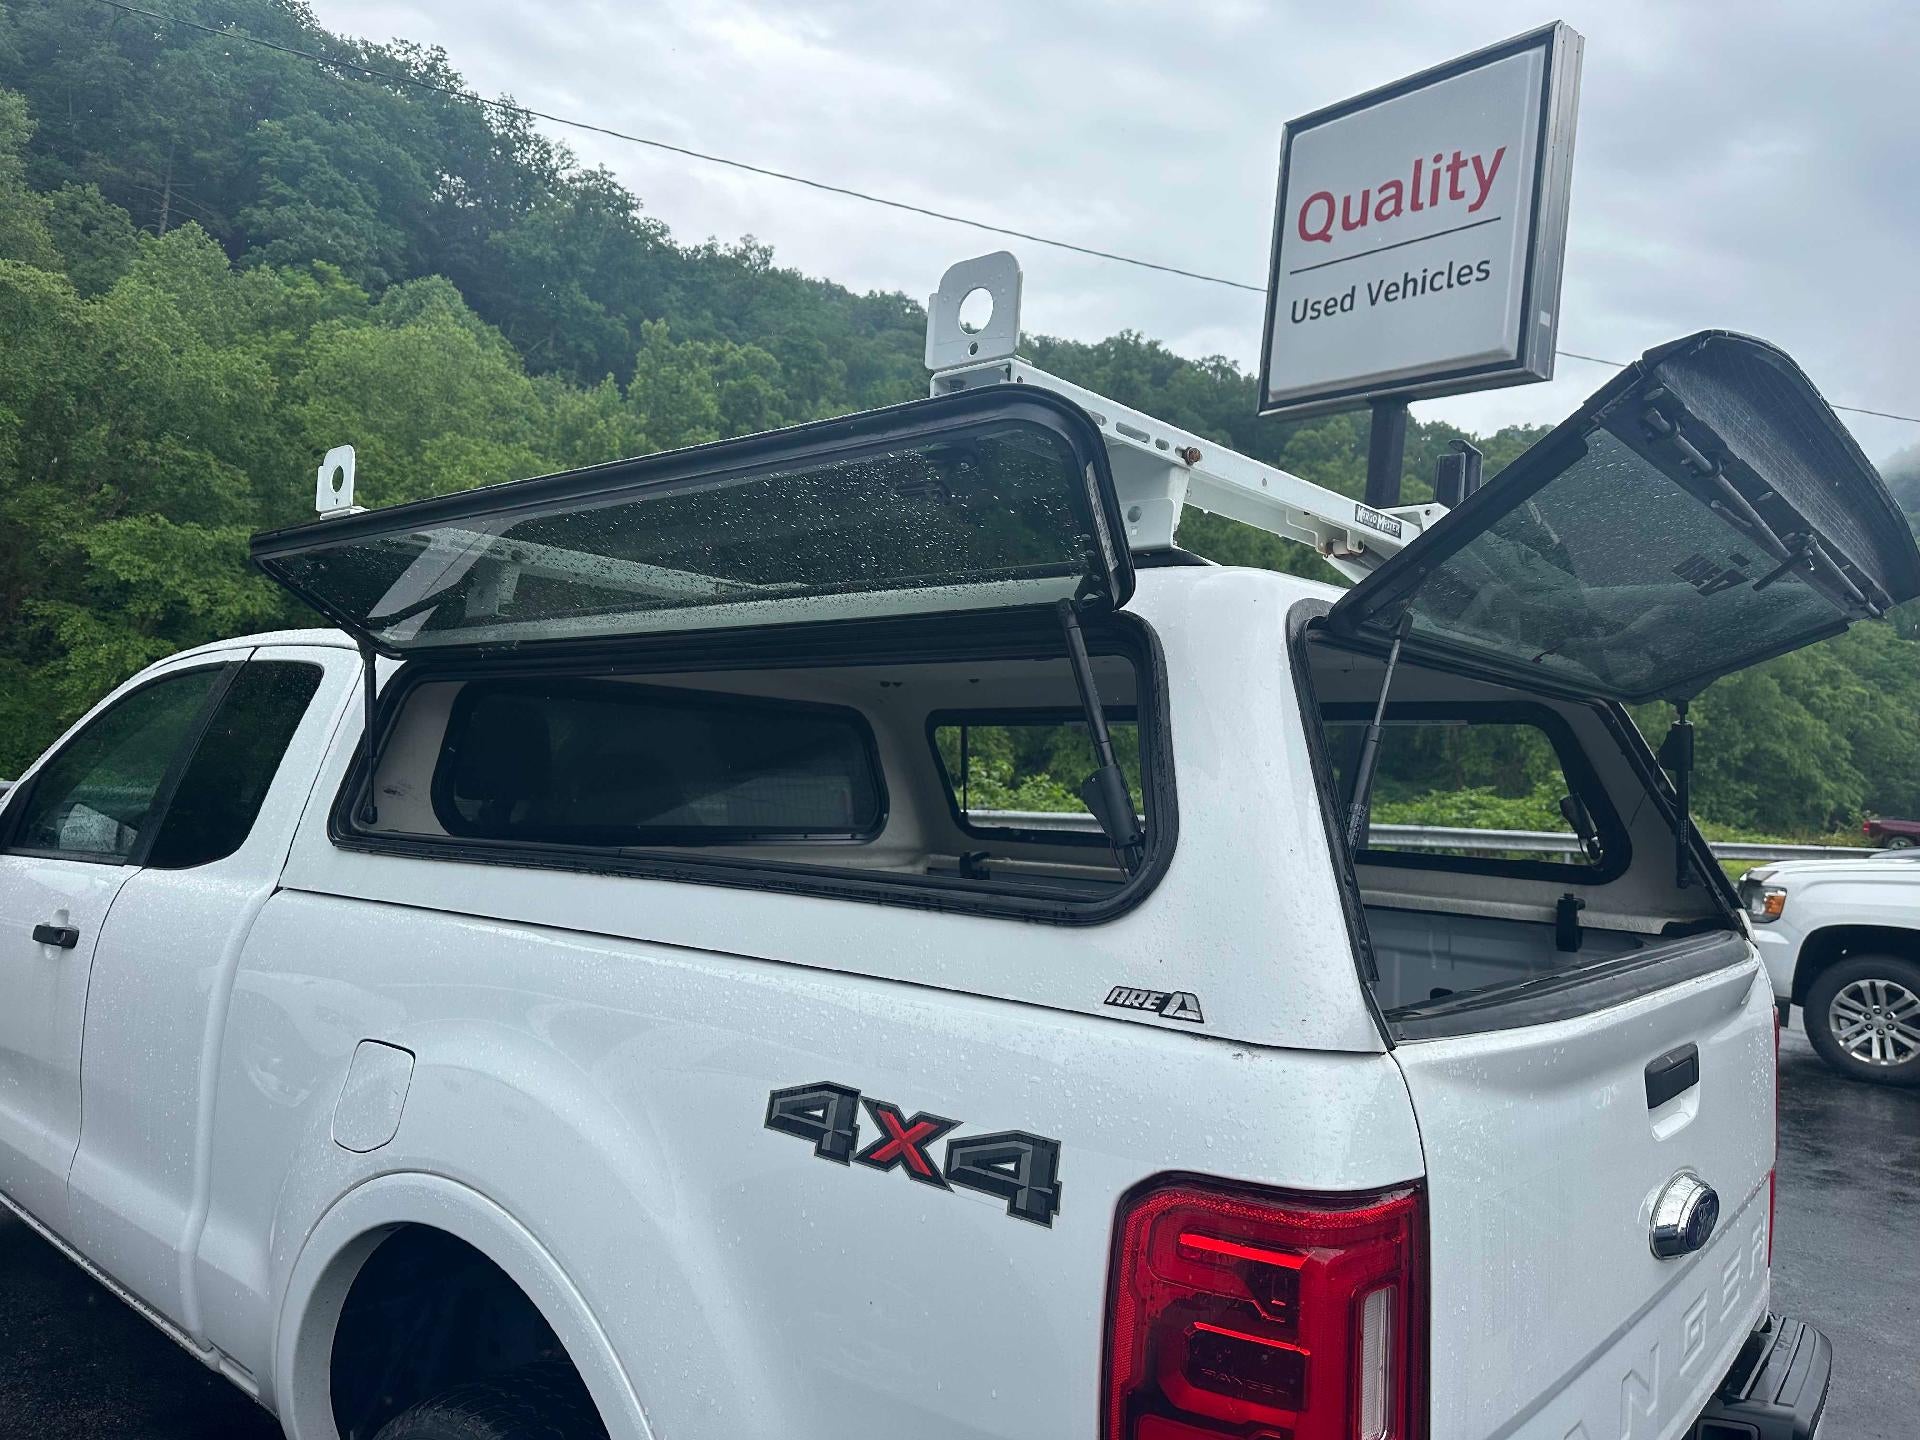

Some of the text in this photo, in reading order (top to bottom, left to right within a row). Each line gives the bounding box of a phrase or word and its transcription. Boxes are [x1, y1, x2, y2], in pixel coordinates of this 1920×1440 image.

[1297, 145, 1507, 243] Quality
[1290, 258, 1491, 324] Used Vehicles
[764, 1081, 1061, 1229] 4X4
